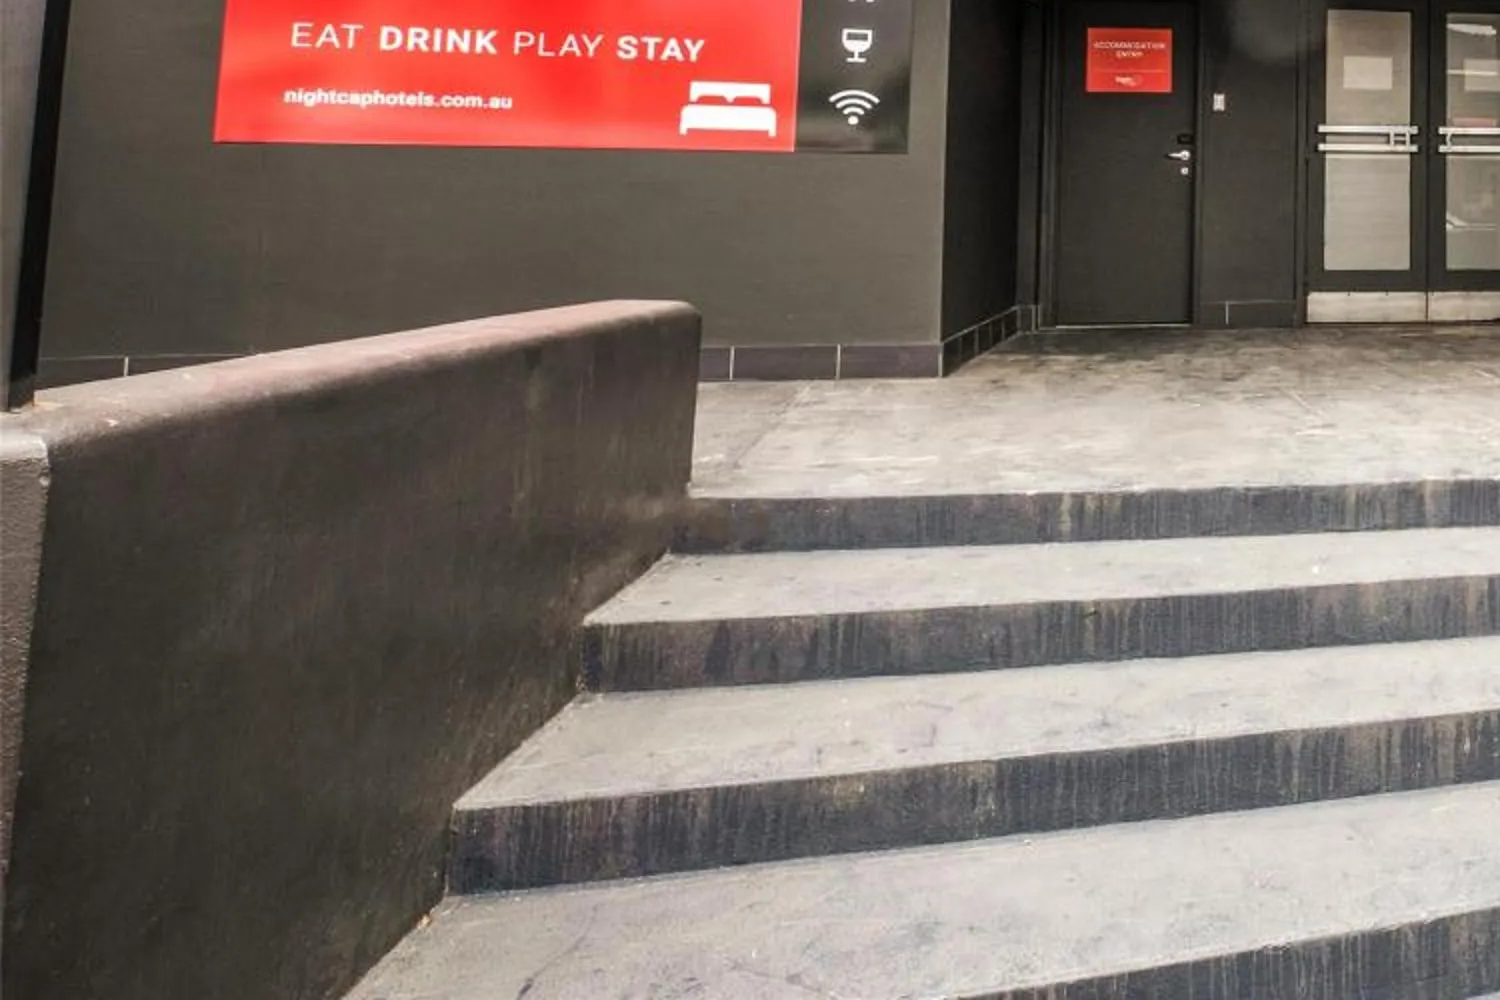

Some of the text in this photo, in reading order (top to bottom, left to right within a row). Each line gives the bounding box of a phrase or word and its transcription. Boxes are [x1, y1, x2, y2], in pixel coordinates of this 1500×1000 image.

[291, 23, 706, 63] EAT DRINK PLAY STAY
[284, 88, 513, 110] nightcaphotels.com.au
